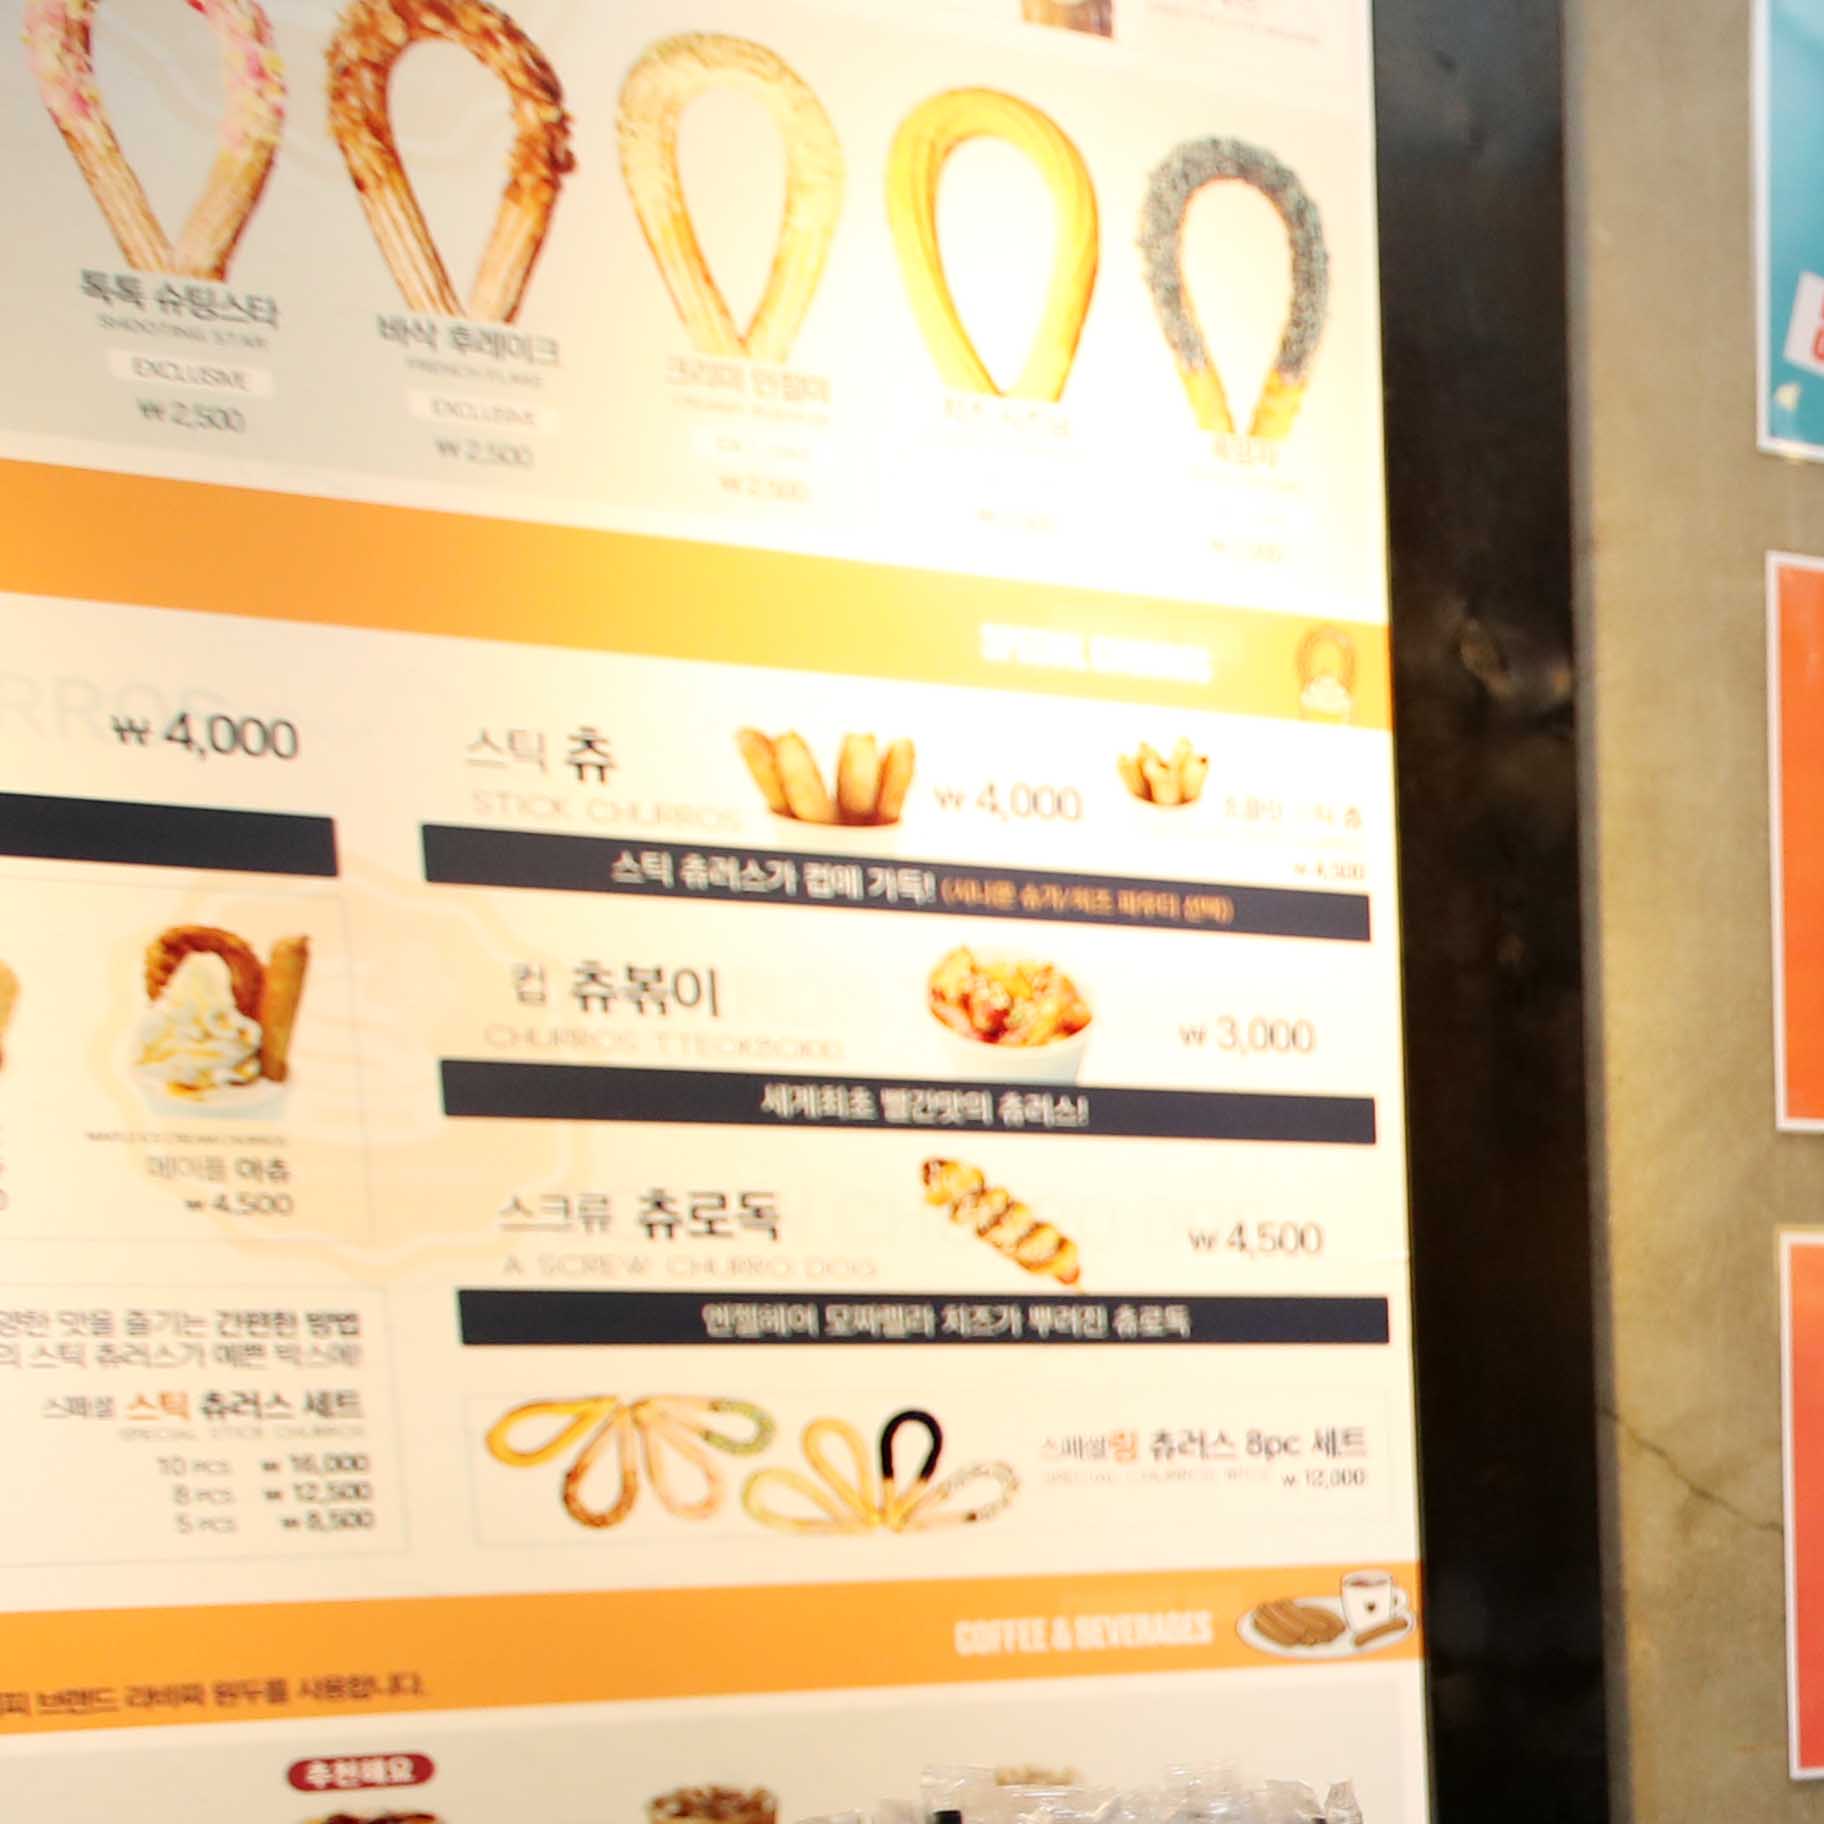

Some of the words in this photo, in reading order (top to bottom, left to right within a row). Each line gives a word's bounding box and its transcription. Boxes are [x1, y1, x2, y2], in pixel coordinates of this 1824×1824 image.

[466, 726, 549, 777] 스틱
[565, 724, 616, 784] 츄
[611, 849, 672, 889] 스틱
[514, 963, 548, 1007] 컵
[571, 960, 721, 1018] 츄볶이
[499, 1192, 612, 1234] 스크류
[638, 1187, 782, 1242] 츄로독
[126, 1389, 191, 1421] 스틱
[198, 1388, 295, 1421] 츄러스
[955, 1618, 1048, 1656] COFFEE
[1075, 1609, 1214, 1652] BEVERAGES
[305, 1756, 418, 1790] 추천해요
